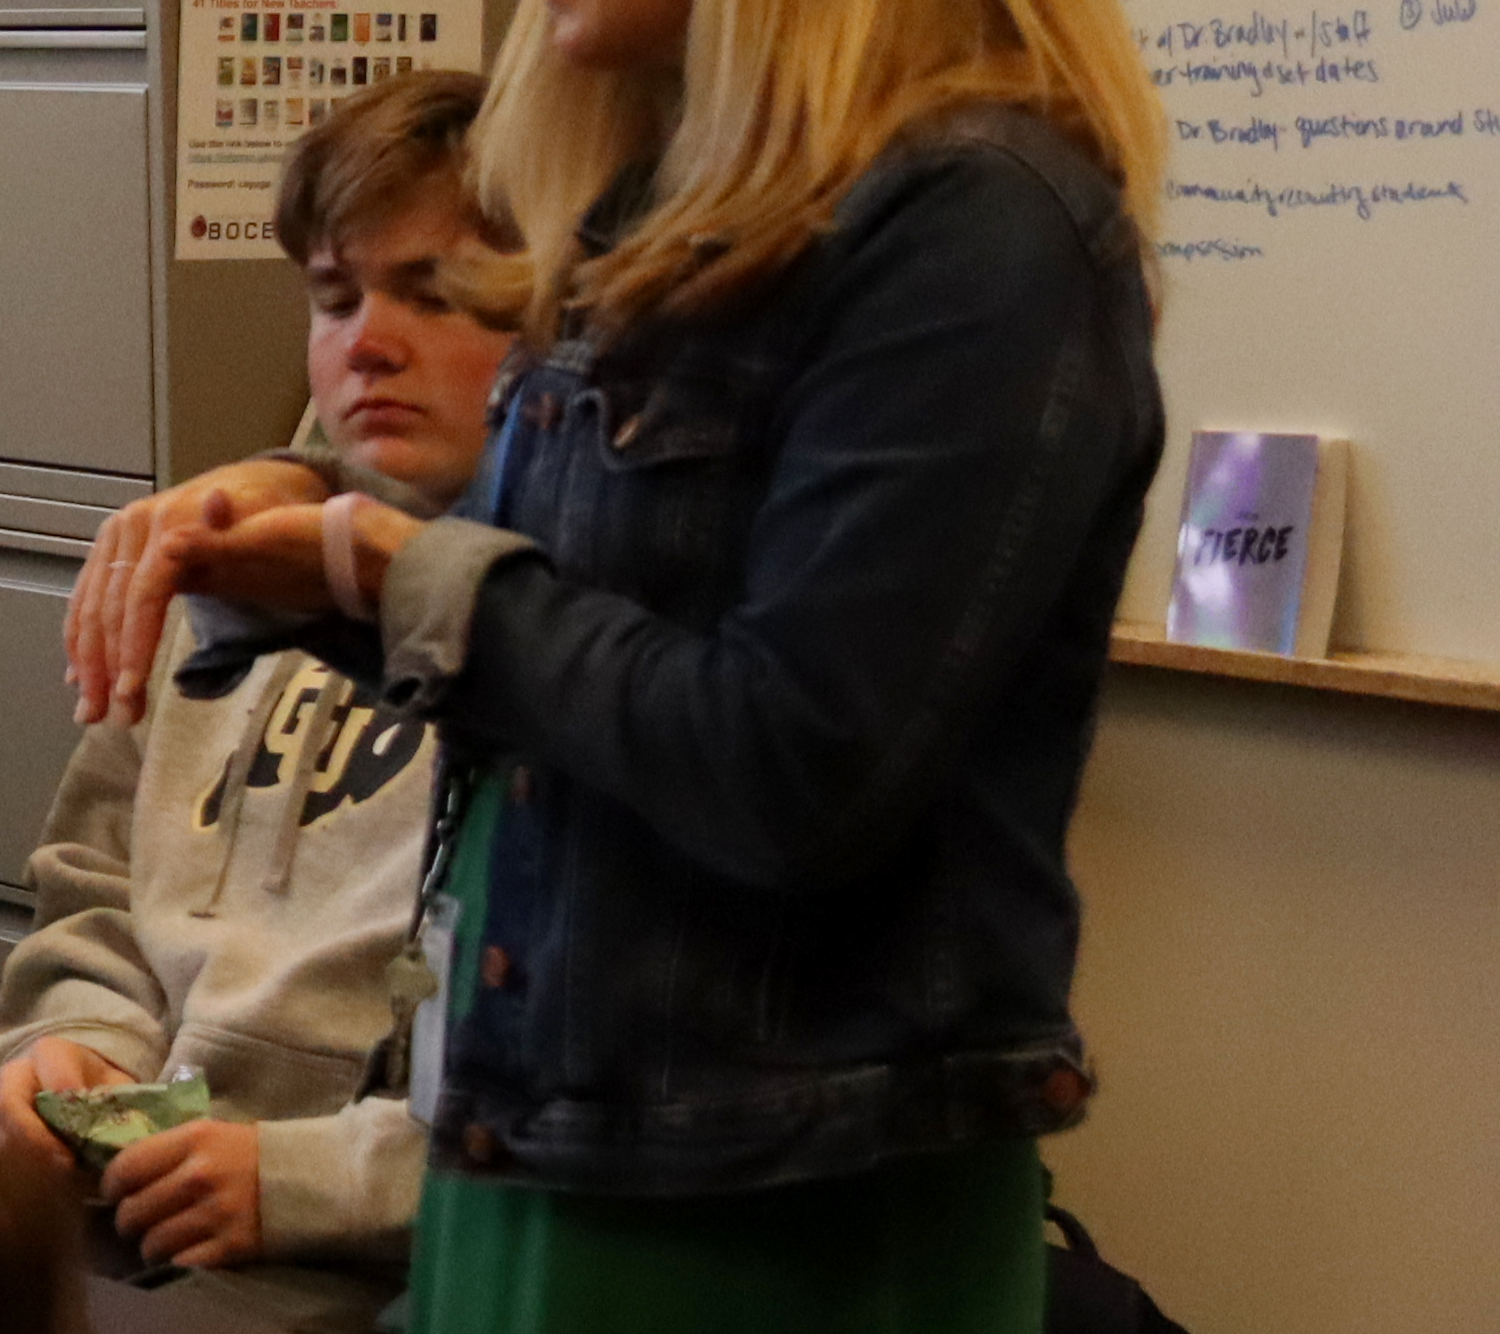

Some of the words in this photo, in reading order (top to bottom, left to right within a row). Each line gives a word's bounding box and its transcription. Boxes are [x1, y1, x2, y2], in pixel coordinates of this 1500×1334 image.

[1315, 58, 1379, 83] dates
[1394, 111, 1464, 141] around
[208, 222, 274, 241] BOCE
